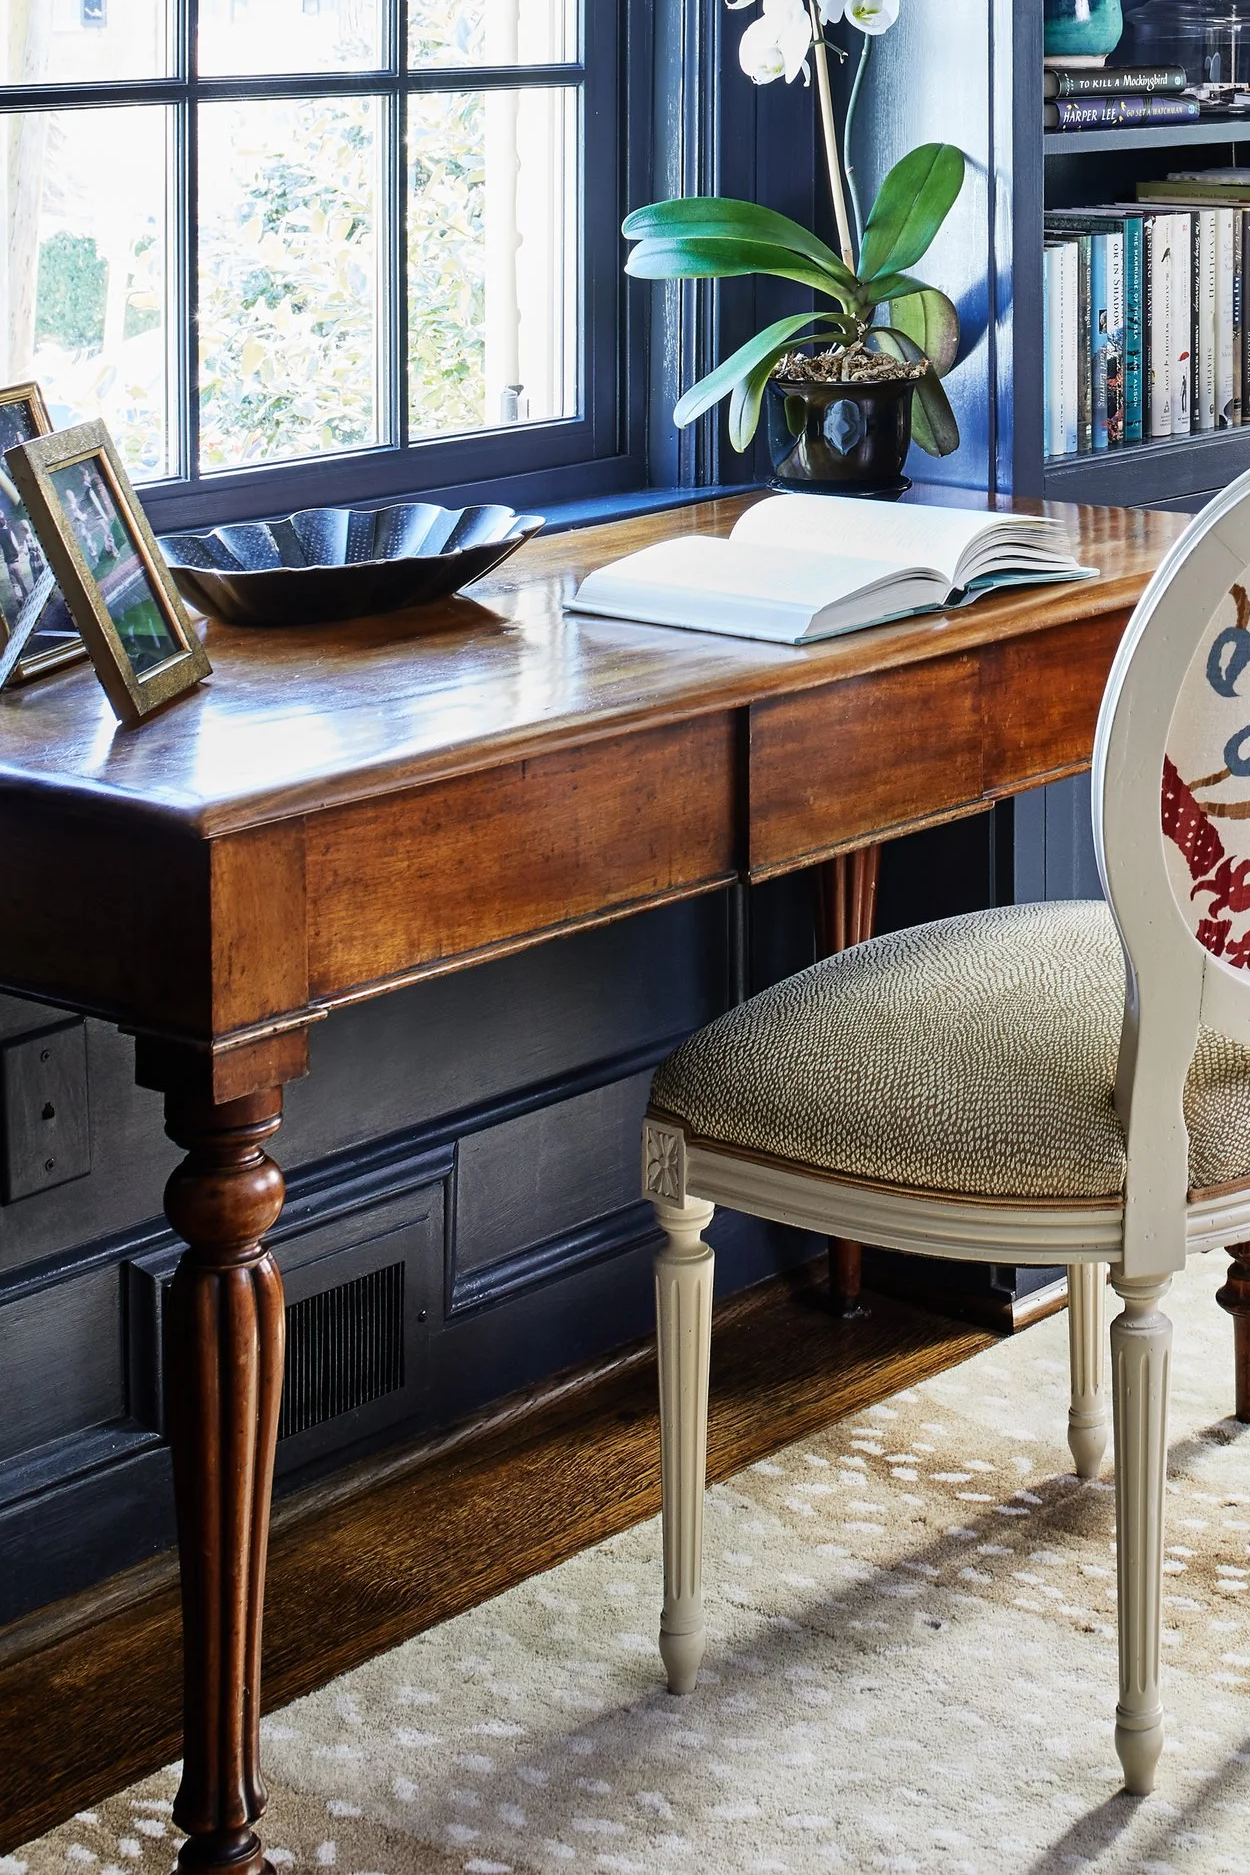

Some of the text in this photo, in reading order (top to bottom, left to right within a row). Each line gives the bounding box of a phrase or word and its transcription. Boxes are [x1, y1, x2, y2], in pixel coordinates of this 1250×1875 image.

[1080, 73, 1168, 92] TO KILL A Mockingbird
[1063, 108, 1116, 123] HARPER LEE
[1126, 106, 1184, 118] GO SET WATCHMAN
[1113, 243, 1121, 327] OR IN SHADOW
[1097, 372, 1106, 407] Earring
